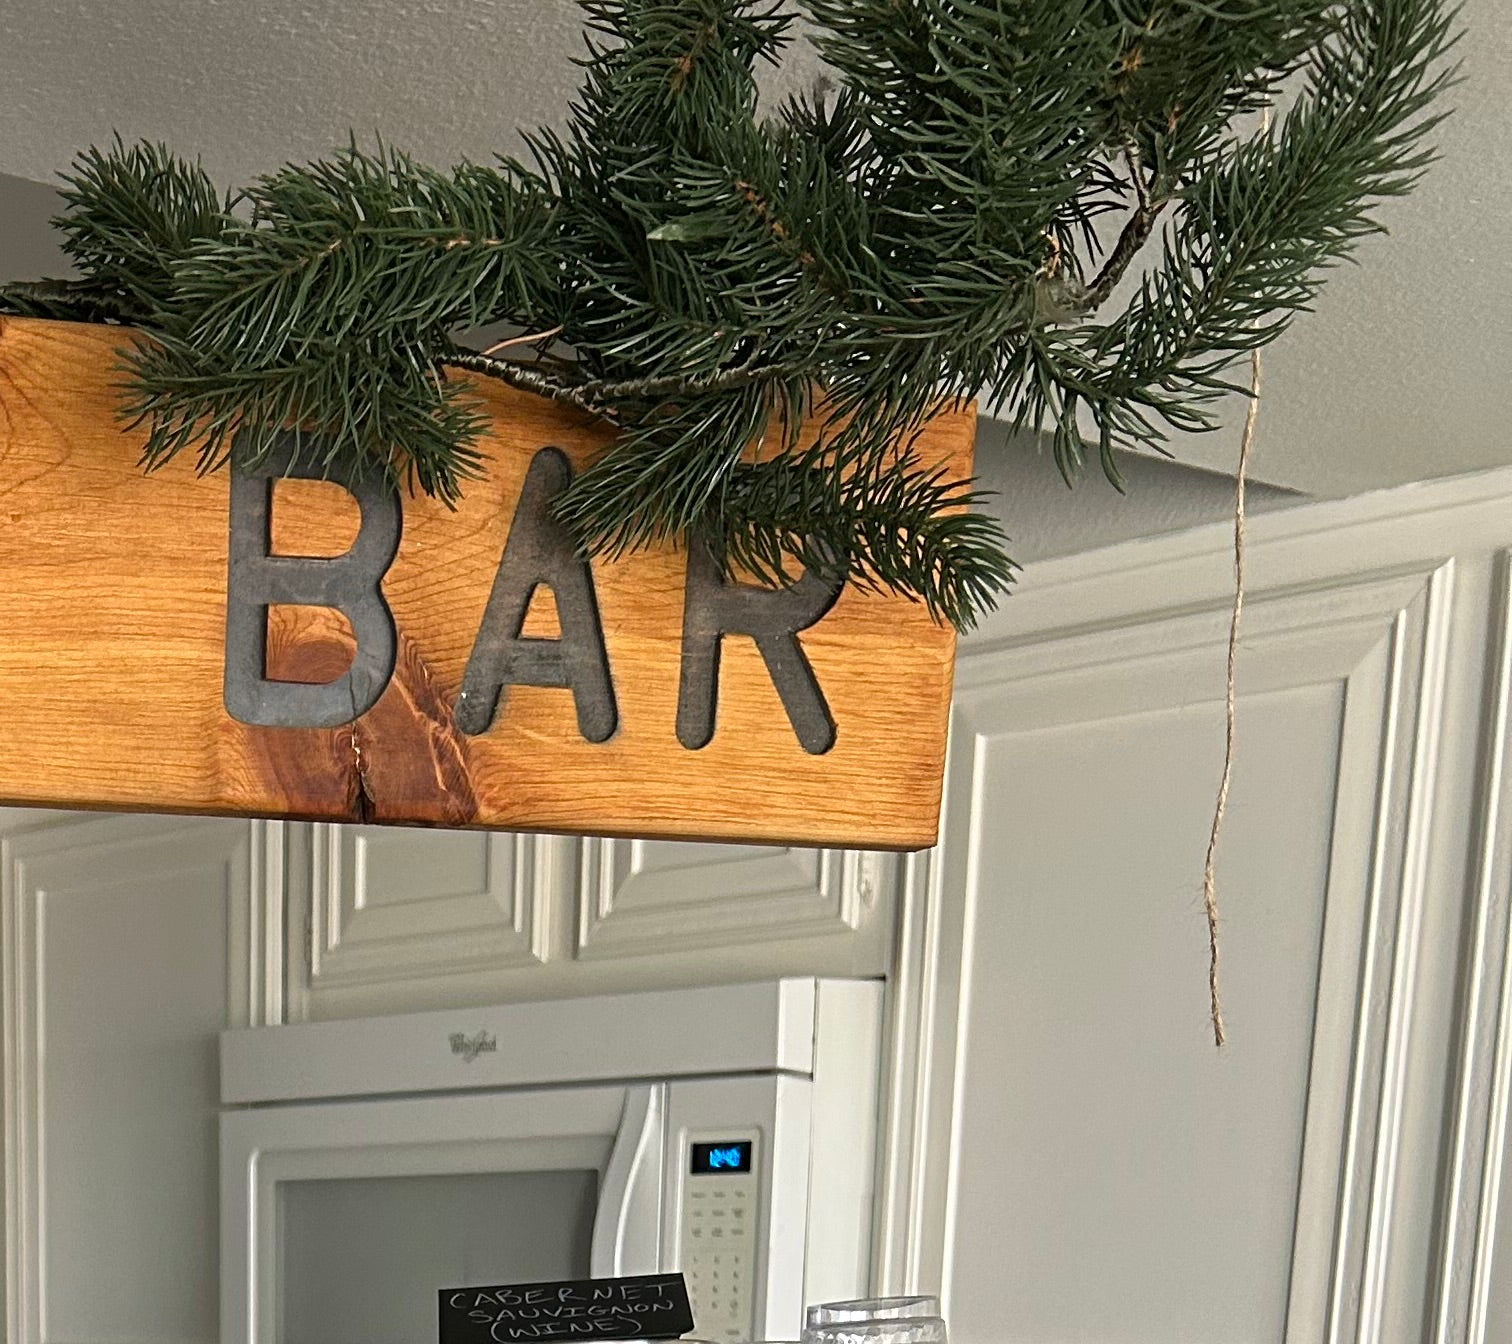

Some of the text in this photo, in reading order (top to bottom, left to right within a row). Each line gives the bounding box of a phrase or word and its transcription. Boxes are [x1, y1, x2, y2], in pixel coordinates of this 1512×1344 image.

[223, 431, 845, 756] BAR
[449, 1280, 683, 1308] CABERNET
[468, 1299, 674, 1324] SAUVIGNON
[490, 1314, 642, 1344] (WINE)
